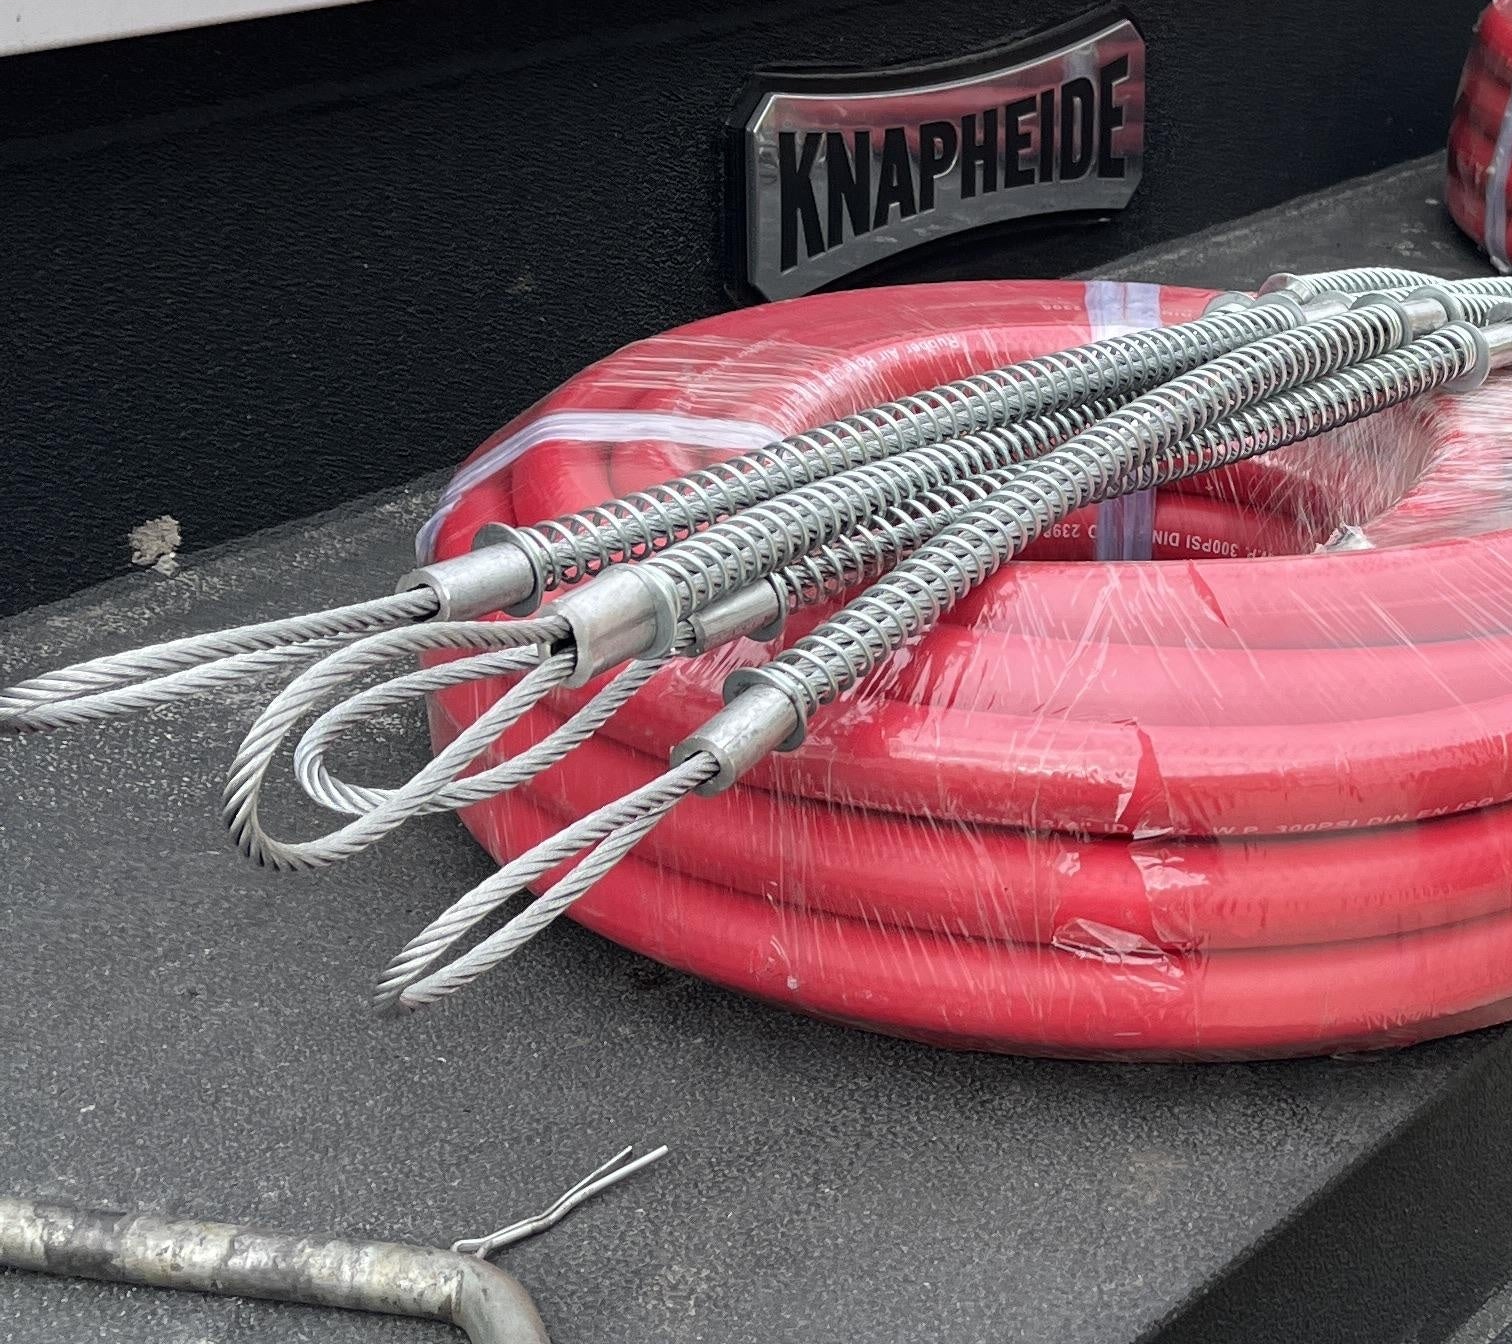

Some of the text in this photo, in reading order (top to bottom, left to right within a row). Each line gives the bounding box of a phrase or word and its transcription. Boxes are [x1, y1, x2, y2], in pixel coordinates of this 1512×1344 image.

[778, 54, 1131, 273] KNAPHEIDE
[1152, 529, 1181, 547] DIN
[1186, 536, 1238, 559] 300PSI
[1275, 818, 1358, 834] 300PSI
[1366, 813, 1410, 827] DIN
[1456, 796, 1495, 812] ISO
